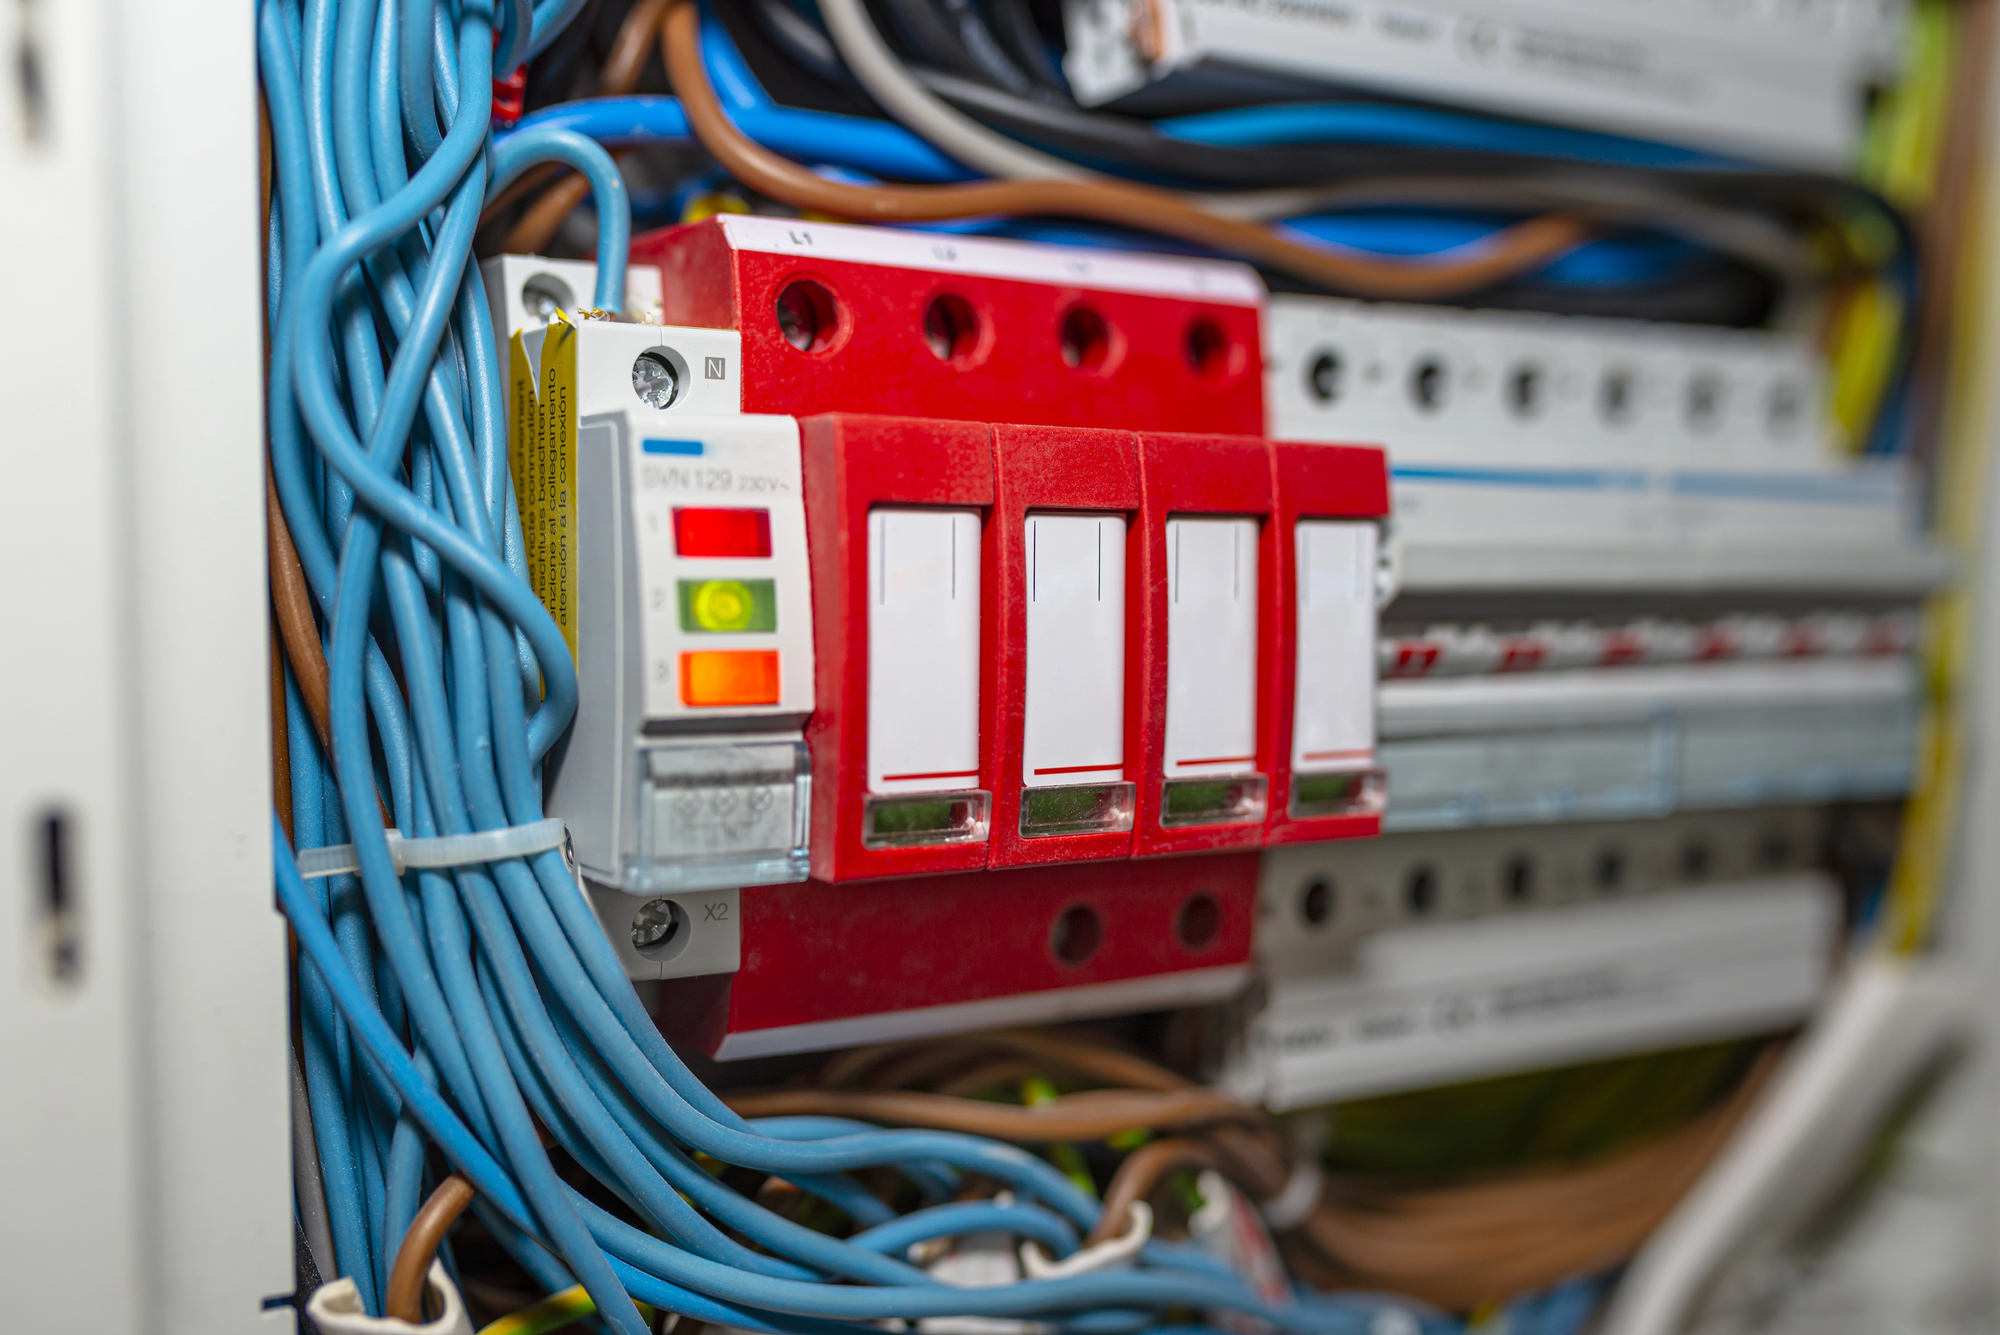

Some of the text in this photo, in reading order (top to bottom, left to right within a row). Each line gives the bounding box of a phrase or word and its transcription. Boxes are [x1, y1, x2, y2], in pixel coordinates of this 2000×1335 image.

[787, 230, 813, 246] L1
[707, 358, 722, 378] N
[516, 380, 526, 515] branchement
[527, 391, 536, 505] connection
[537, 404, 546, 501] beachten
[548, 368, 558, 622] enzione al collegamento
[694, 467, 733, 491] 129
[558, 387, 567, 626] atención a la conexión
[704, 903, 728, 921] X2
